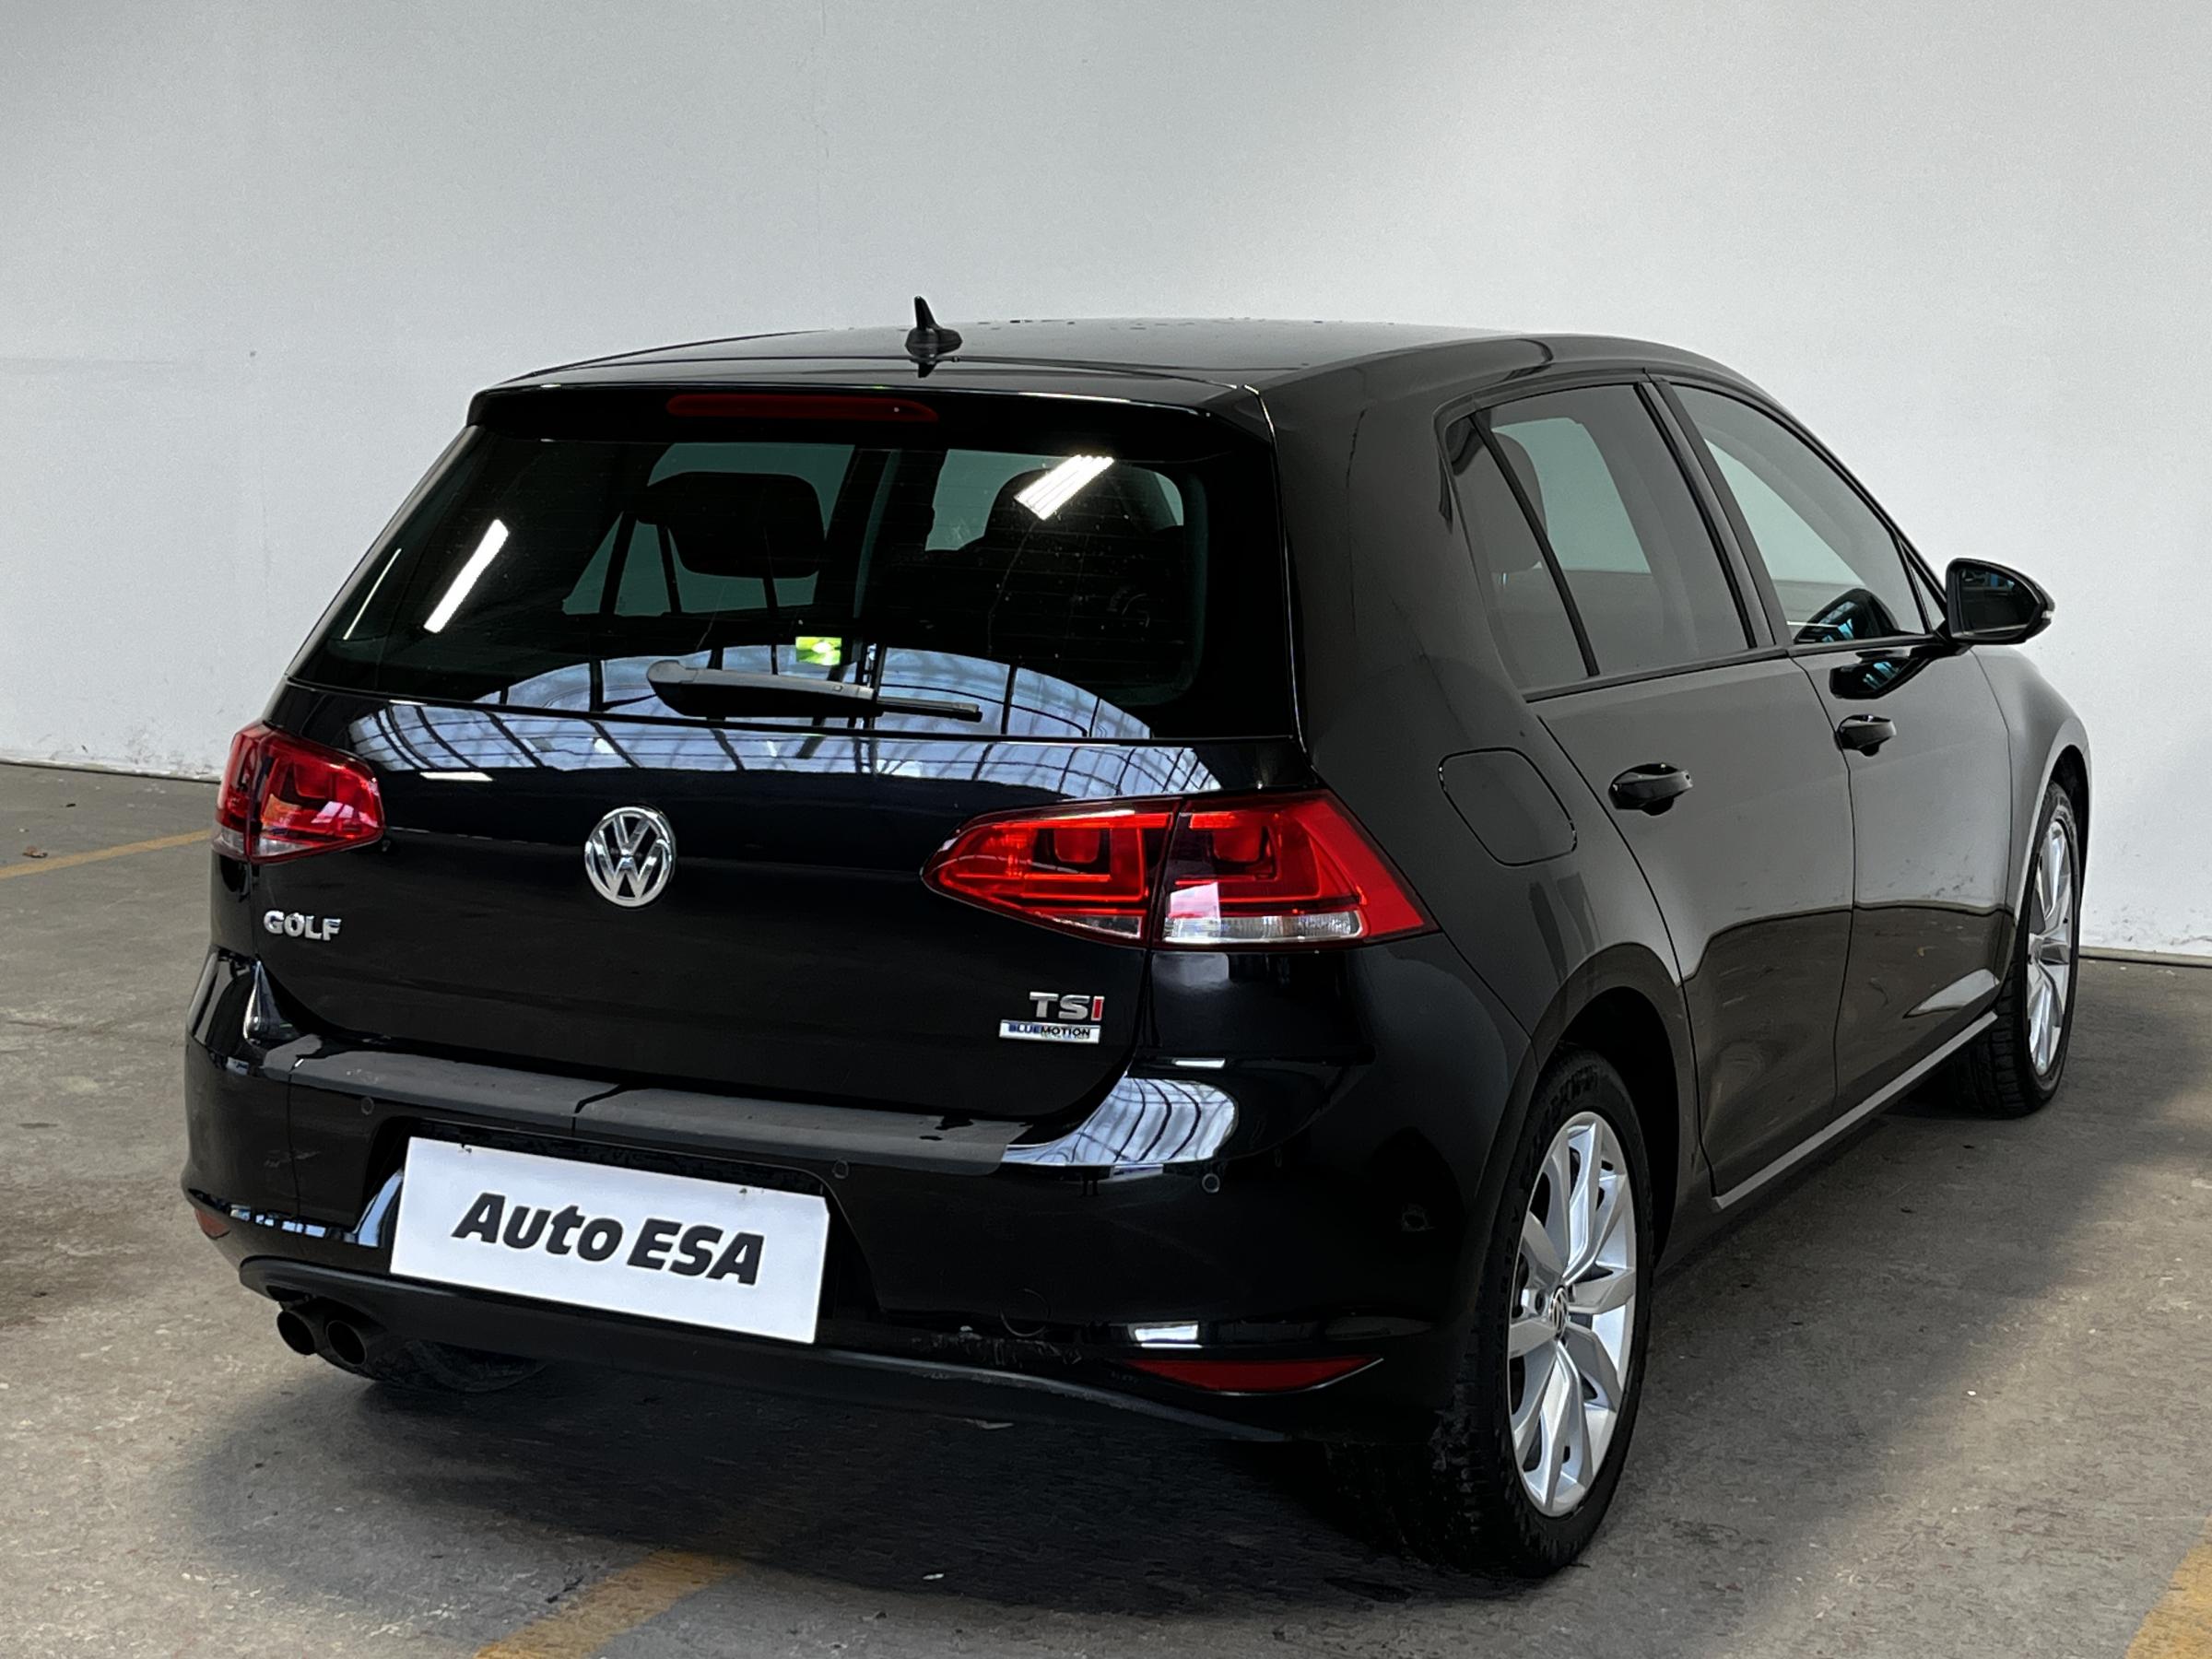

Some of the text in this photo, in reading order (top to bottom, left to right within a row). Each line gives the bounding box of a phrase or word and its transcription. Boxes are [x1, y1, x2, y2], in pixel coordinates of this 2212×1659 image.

[263, 910, 342, 941] GOLF
[1029, 991, 1105, 1021] TSI
[451, 1192, 765, 1286] Auto ESA
